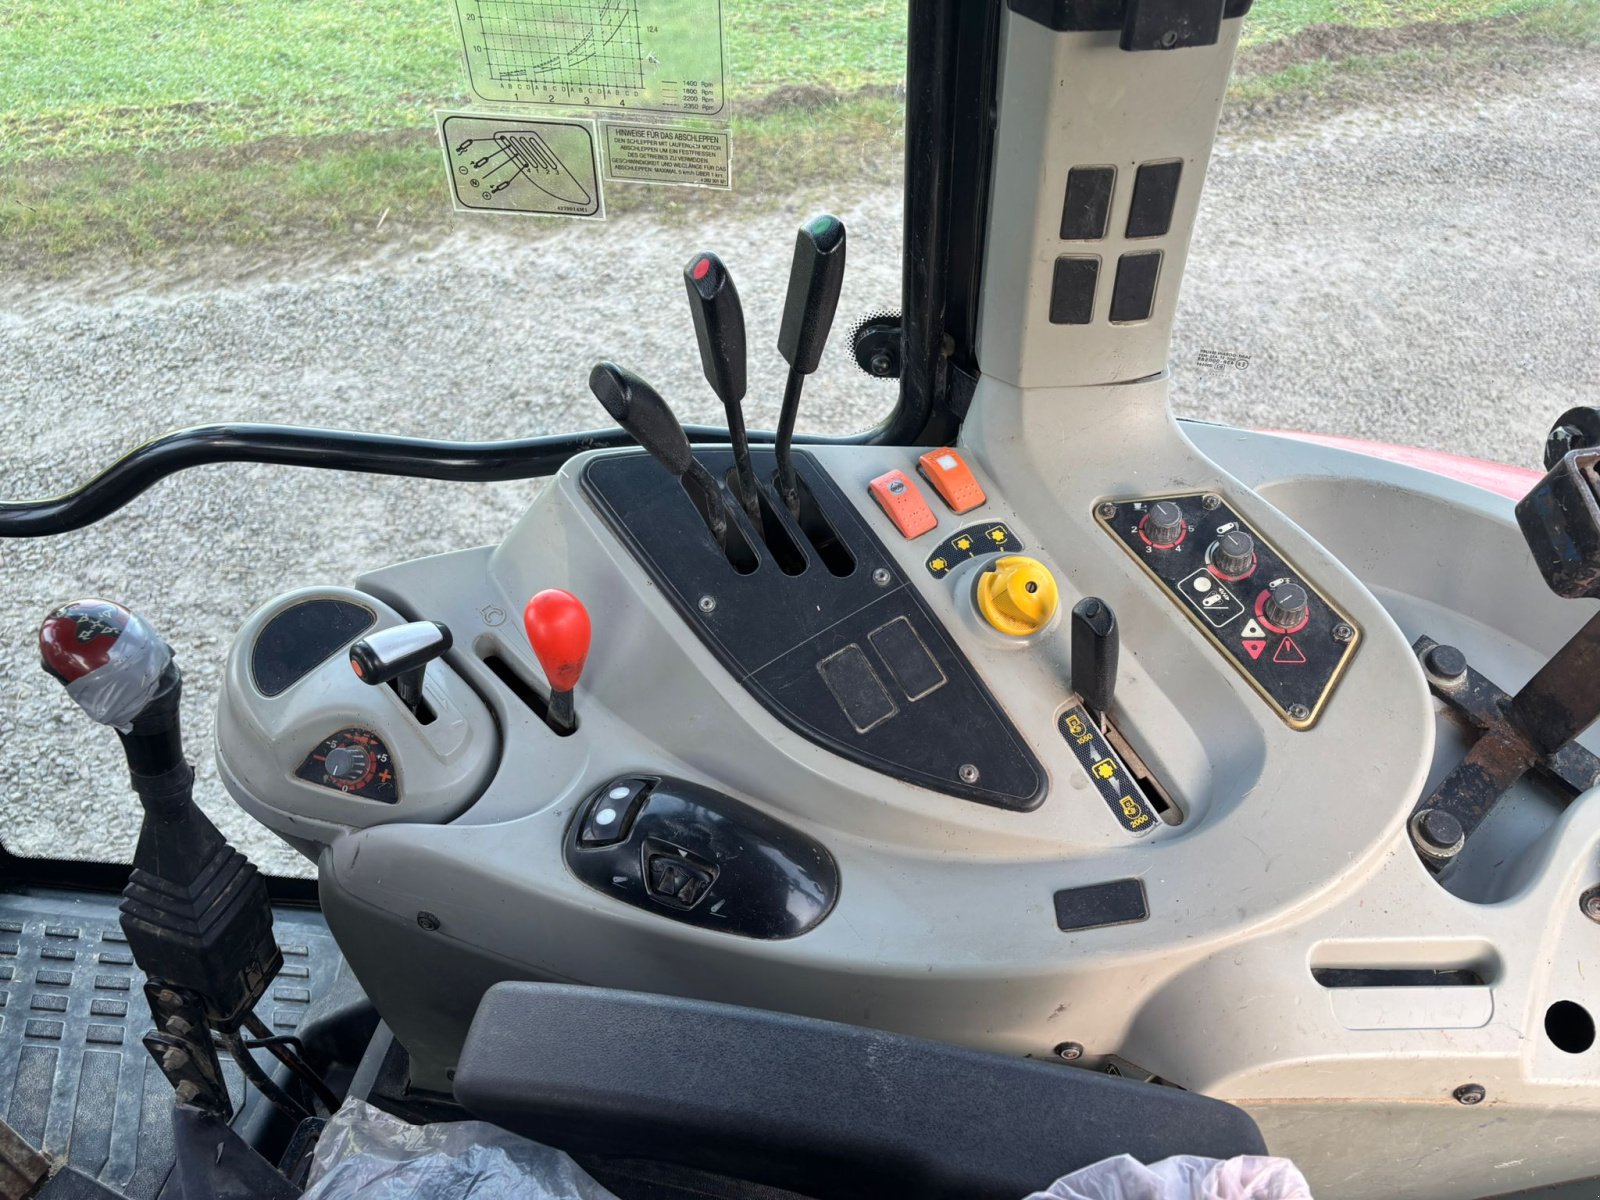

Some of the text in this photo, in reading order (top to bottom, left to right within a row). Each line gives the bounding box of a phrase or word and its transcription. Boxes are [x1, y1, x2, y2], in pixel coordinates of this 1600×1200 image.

[466, 13, 476, 21] 20
[548, 94, 555, 103] 2
[584, 96, 590, 105] 3
[615, 129, 646, 138] HINWEISE
[646, 129, 660, 139] FÜR
[675, 133, 719, 143] ABSCHLEPPEN
[1188, 525, 1195, 533] 5
[342, 785, 349, 793] 0
[1130, 815, 1149, 829] 2000
